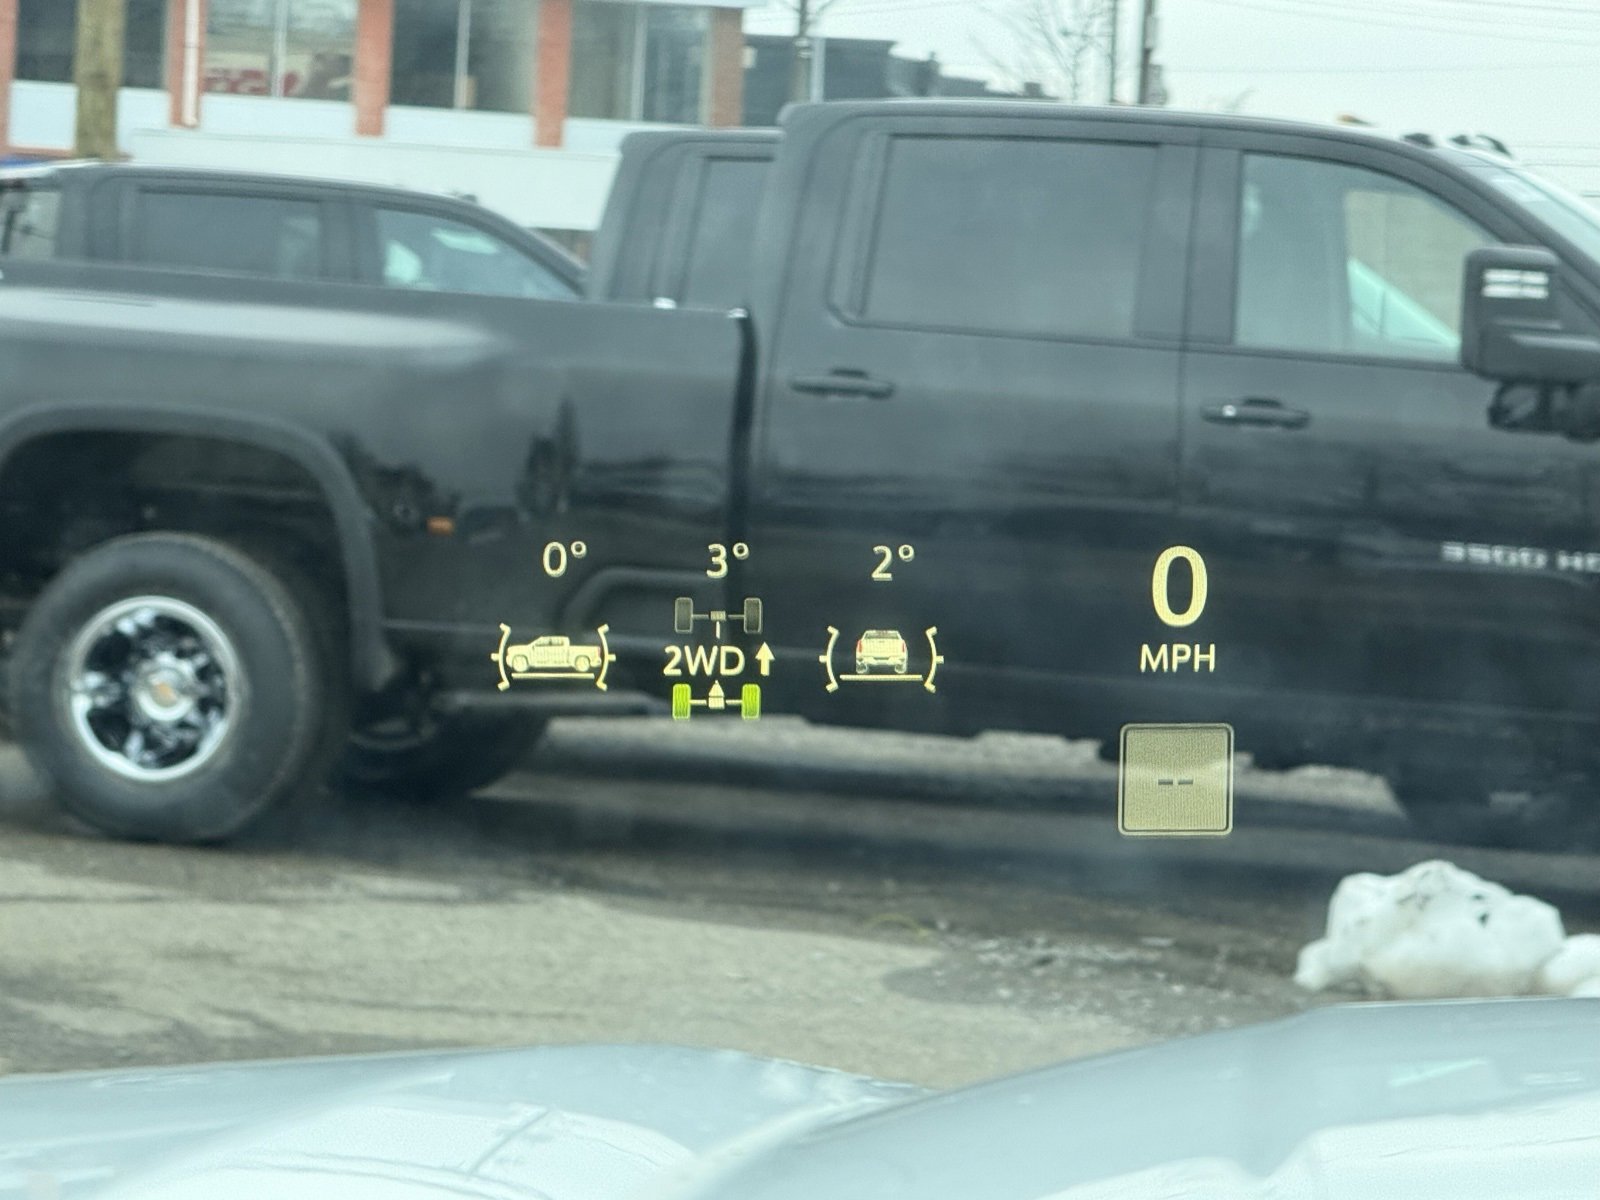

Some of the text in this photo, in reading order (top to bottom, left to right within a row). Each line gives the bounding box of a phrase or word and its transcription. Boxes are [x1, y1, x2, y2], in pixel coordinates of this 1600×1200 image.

[542, 540, 587, 578] 0°
[706, 542, 750, 580] 3°
[871, 544, 915, 582] 2°
[1152, 545, 1208, 627] 0
[663, 645, 746, 677] 2WD
[1139, 643, 1216, 673] MPH
